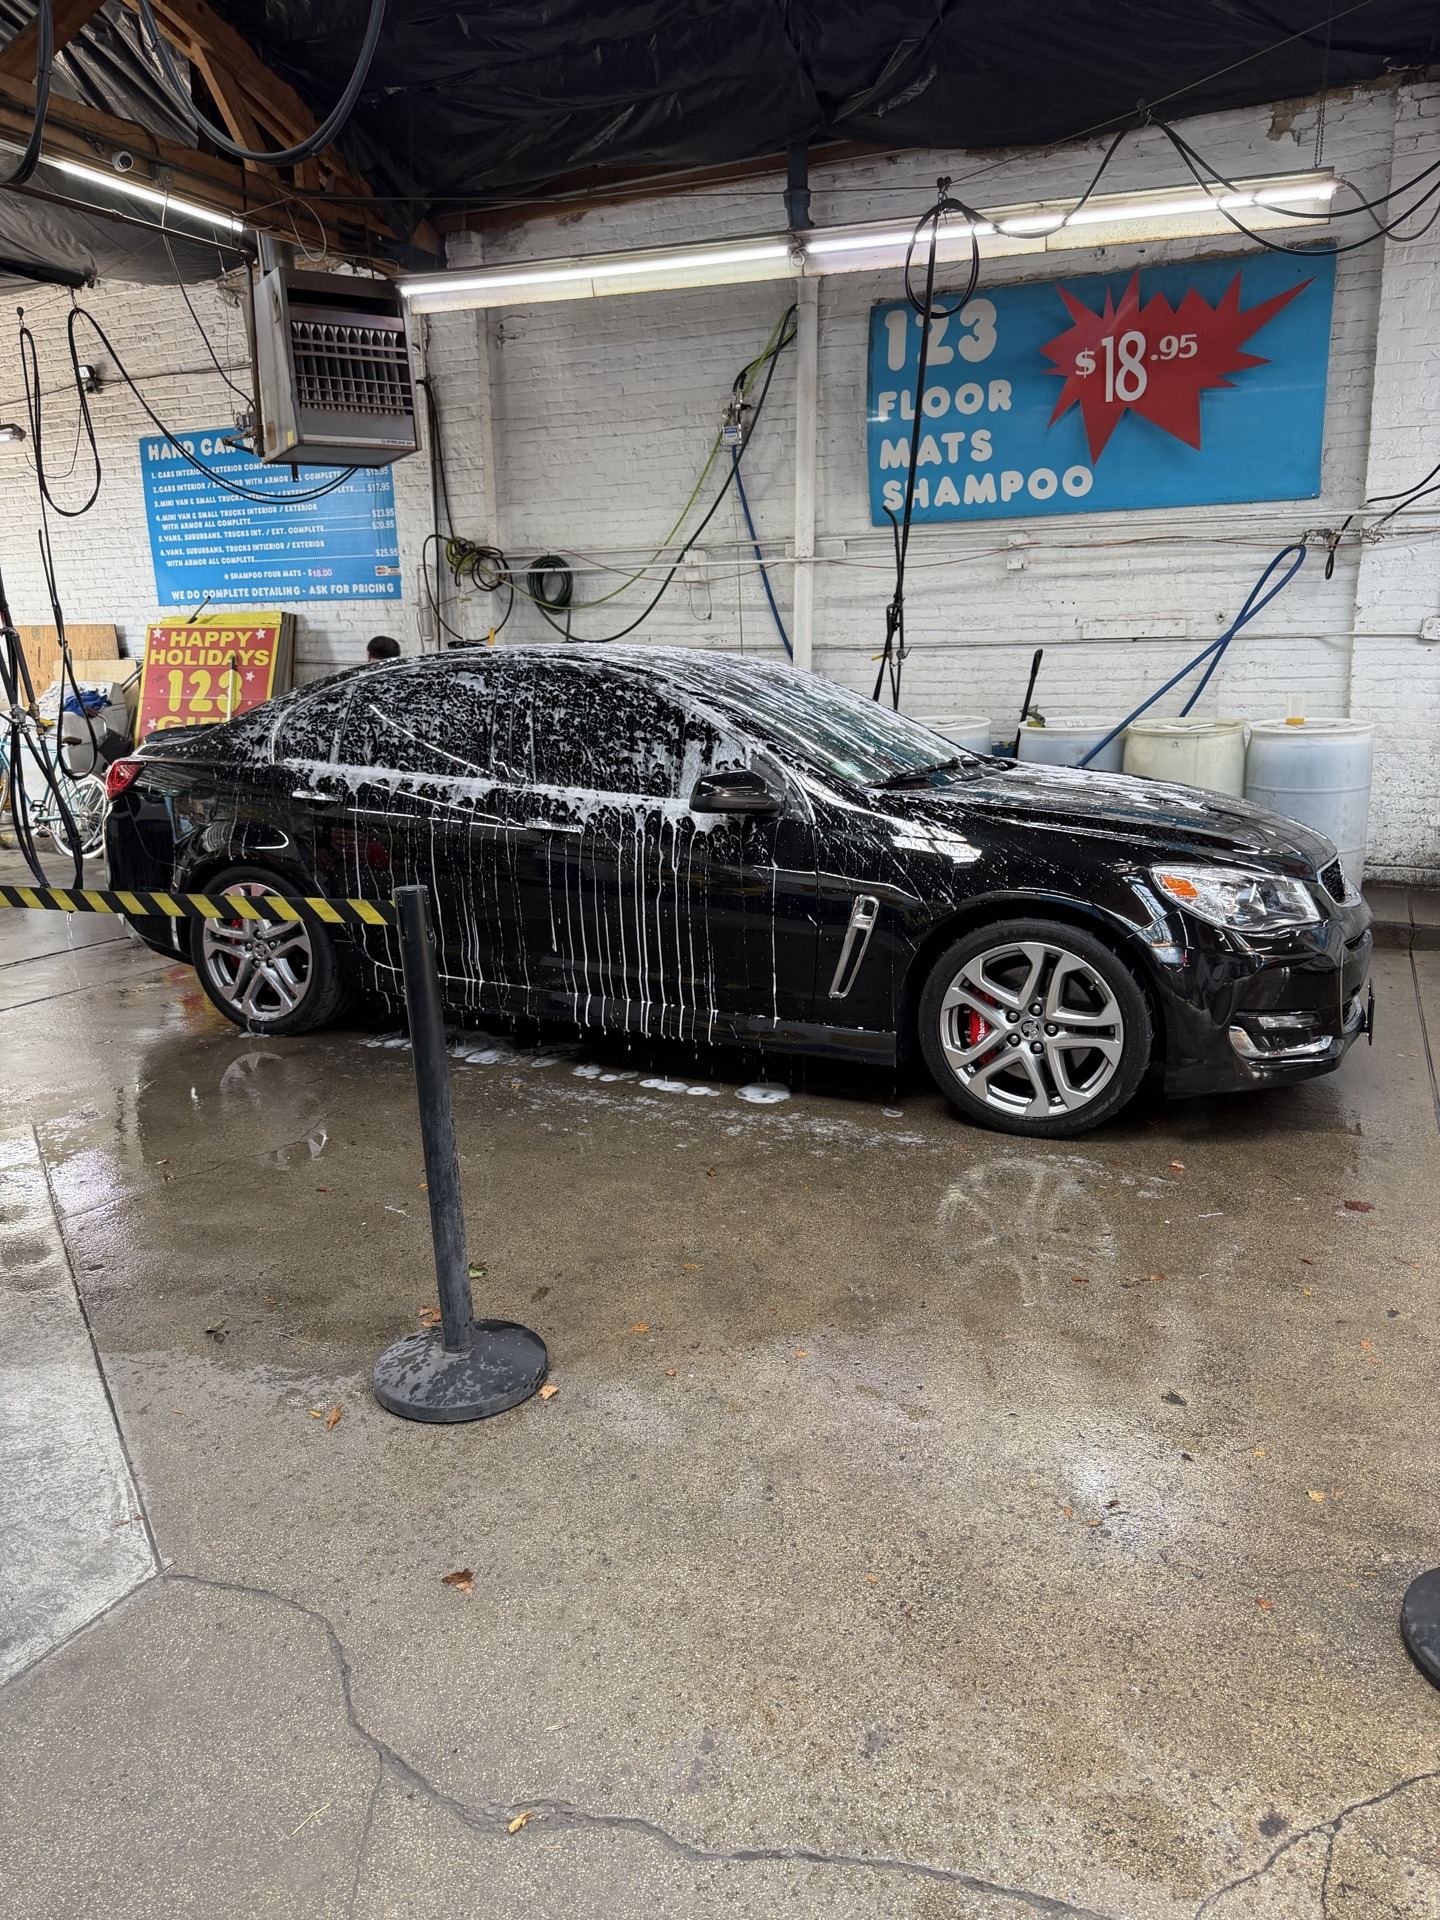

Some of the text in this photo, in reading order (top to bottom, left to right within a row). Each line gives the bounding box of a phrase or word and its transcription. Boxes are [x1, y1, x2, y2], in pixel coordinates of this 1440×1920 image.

[885, 298, 997, 371] 123
[1075, 330, 1199, 404] $18.95
[878, 379, 1012, 422] FLOOR
[880, 429, 993, 470] MATS
[158, 470, 175, 479] CARS
[177, 482, 206, 491] INTERIOR
[245, 477, 263, 485] WITH
[264, 475, 288, 484] ARMOR
[176, 498, 189, 506] VAN
[196, 496, 217, 504] SMALL
[218, 494, 244, 502] TRUCKS
[368, 483, 390, 492] $17.95
[882, 465, 1094, 511] SHAMPOO
[198, 511, 219, 519] SMALL
[220, 508, 246, 517] TRUCKS
[247, 507, 277, 515] INTERIOR
[284, 504, 318, 512] EXTERIOR
[162, 523, 179, 531] WITH
[180, 521, 203, 529] ARMOR
[204, 520, 216, 528] ALL
[224, 529, 249, 538] TRUCKS
[251, 528, 265, 536] INT.
[271, 527, 287, 535] EXT.
[225, 543, 251, 552] TRUCKS
[292, 540, 325, 549] EXTERIOR
[184, 558, 207, 566] ARMOR
[208, 557, 220, 565] ALL
[375, 547, 399, 558] $25.95
[230, 570, 262, 579] SHAMPOO
[263, 570, 281, 578] FOUR
[283, 569, 302, 577] MATS
[171, 590, 185, 600] WE
[187, 590, 200, 599] DO
[202, 588, 249, 599] COMPLETE
[308, 585, 328, 595] ASK
[330, 584, 350, 594] FOR
[352, 583, 395, 593] PRICING
[169, 631, 253, 647] HAPPY
[149, 649, 270, 666] HOLIDAYS
[168, 669, 243, 713] 123
